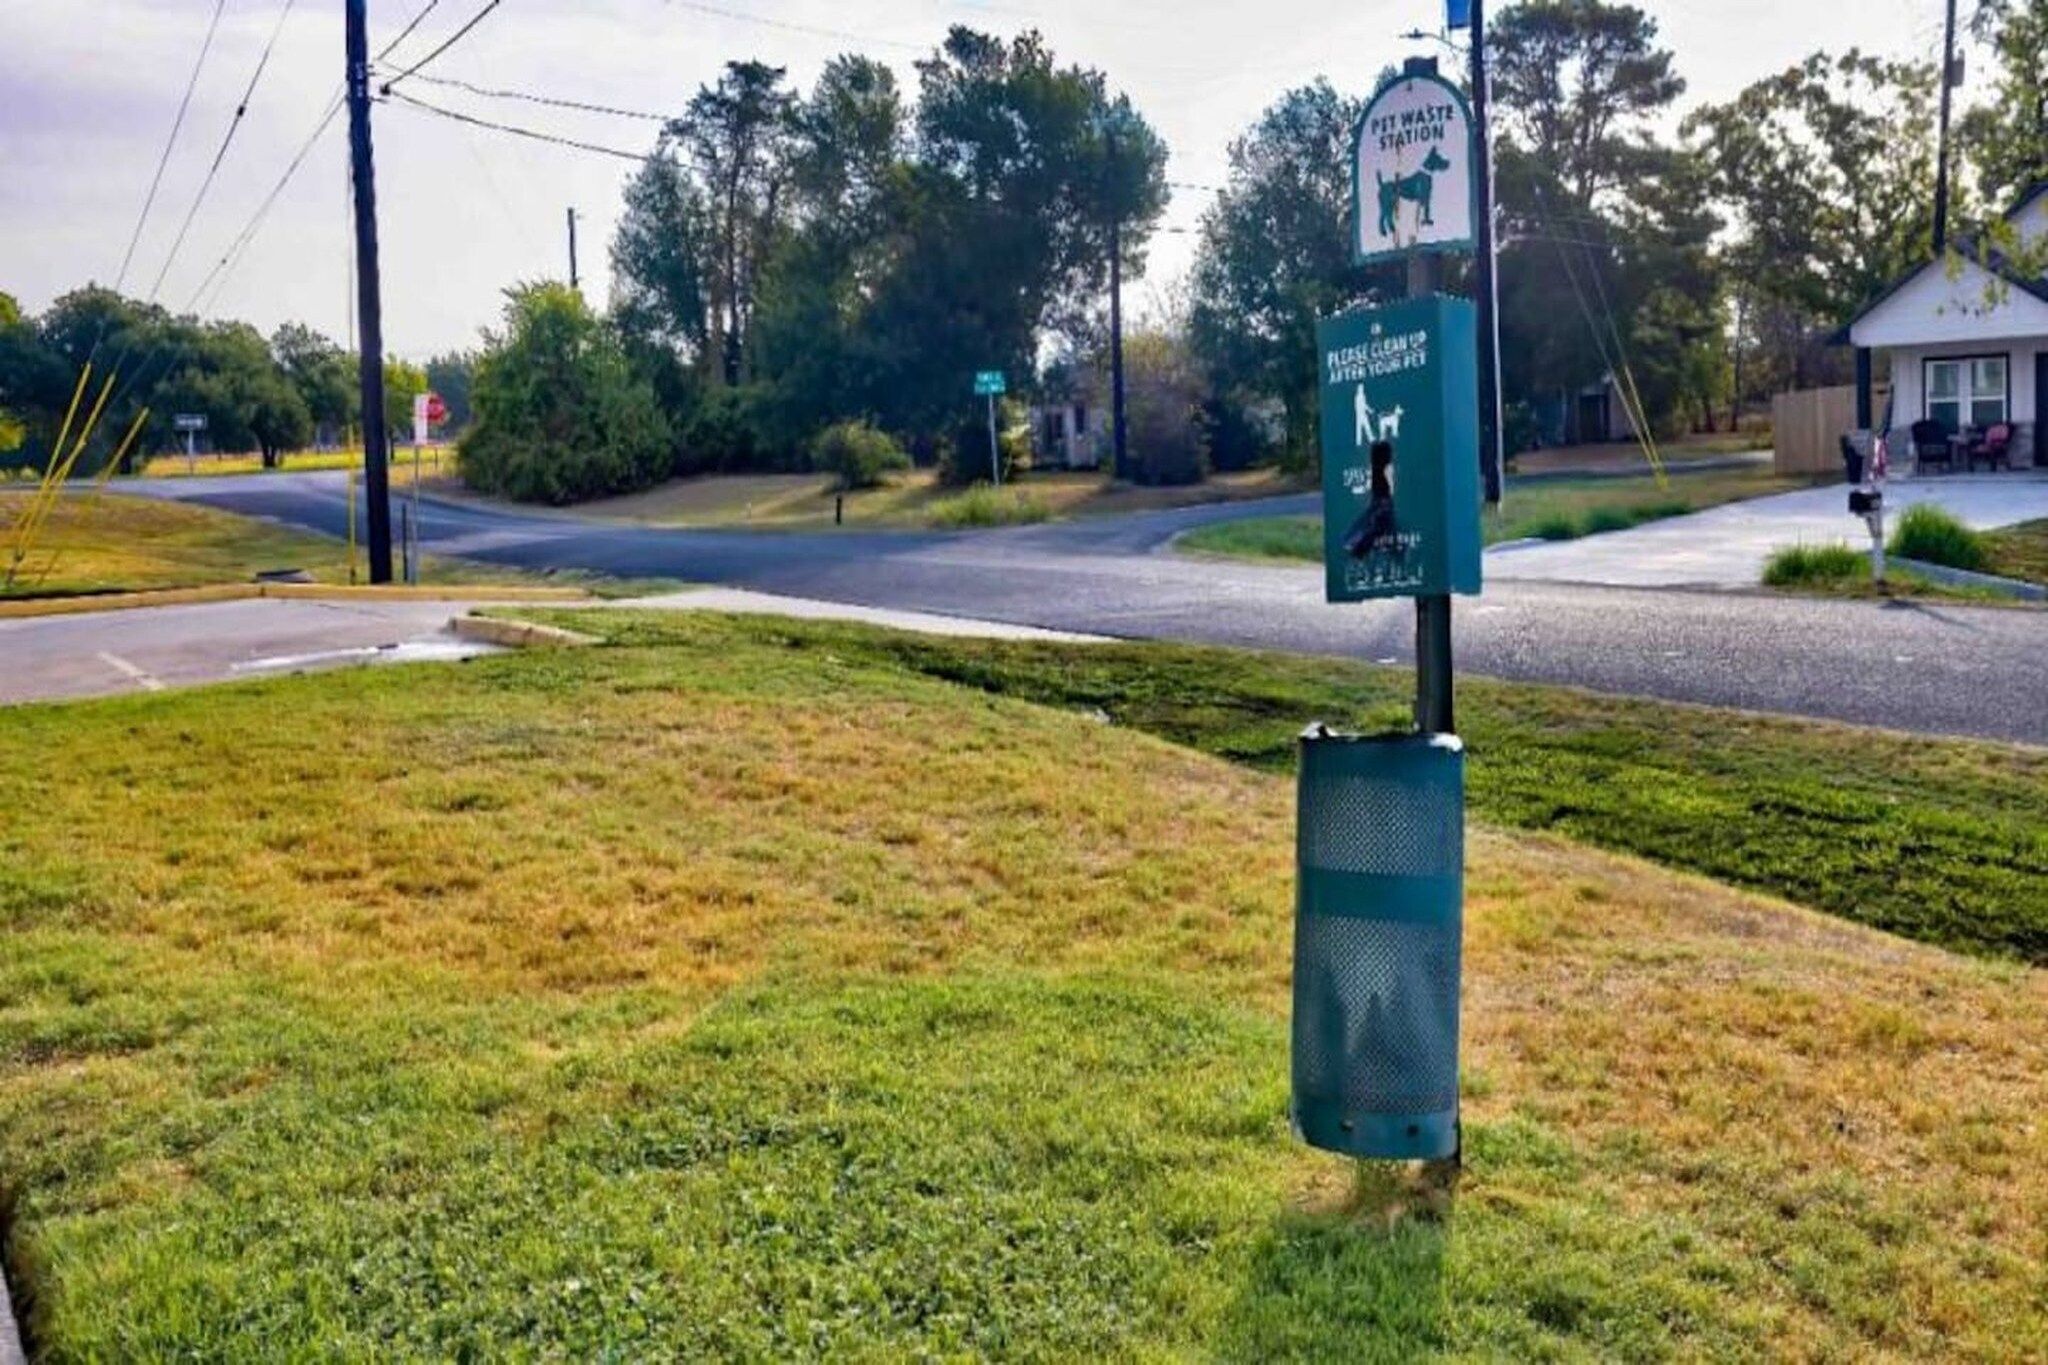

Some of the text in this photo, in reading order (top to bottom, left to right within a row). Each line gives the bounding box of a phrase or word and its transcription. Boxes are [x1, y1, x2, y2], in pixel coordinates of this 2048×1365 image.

[1371, 104, 1454, 135] PET WASTE
[1380, 125, 1445, 150] STATION
[1328, 330, 1427, 368] PLEASE CLEAN UP
[1329, 352, 1426, 384] AFTER YOUR PET
